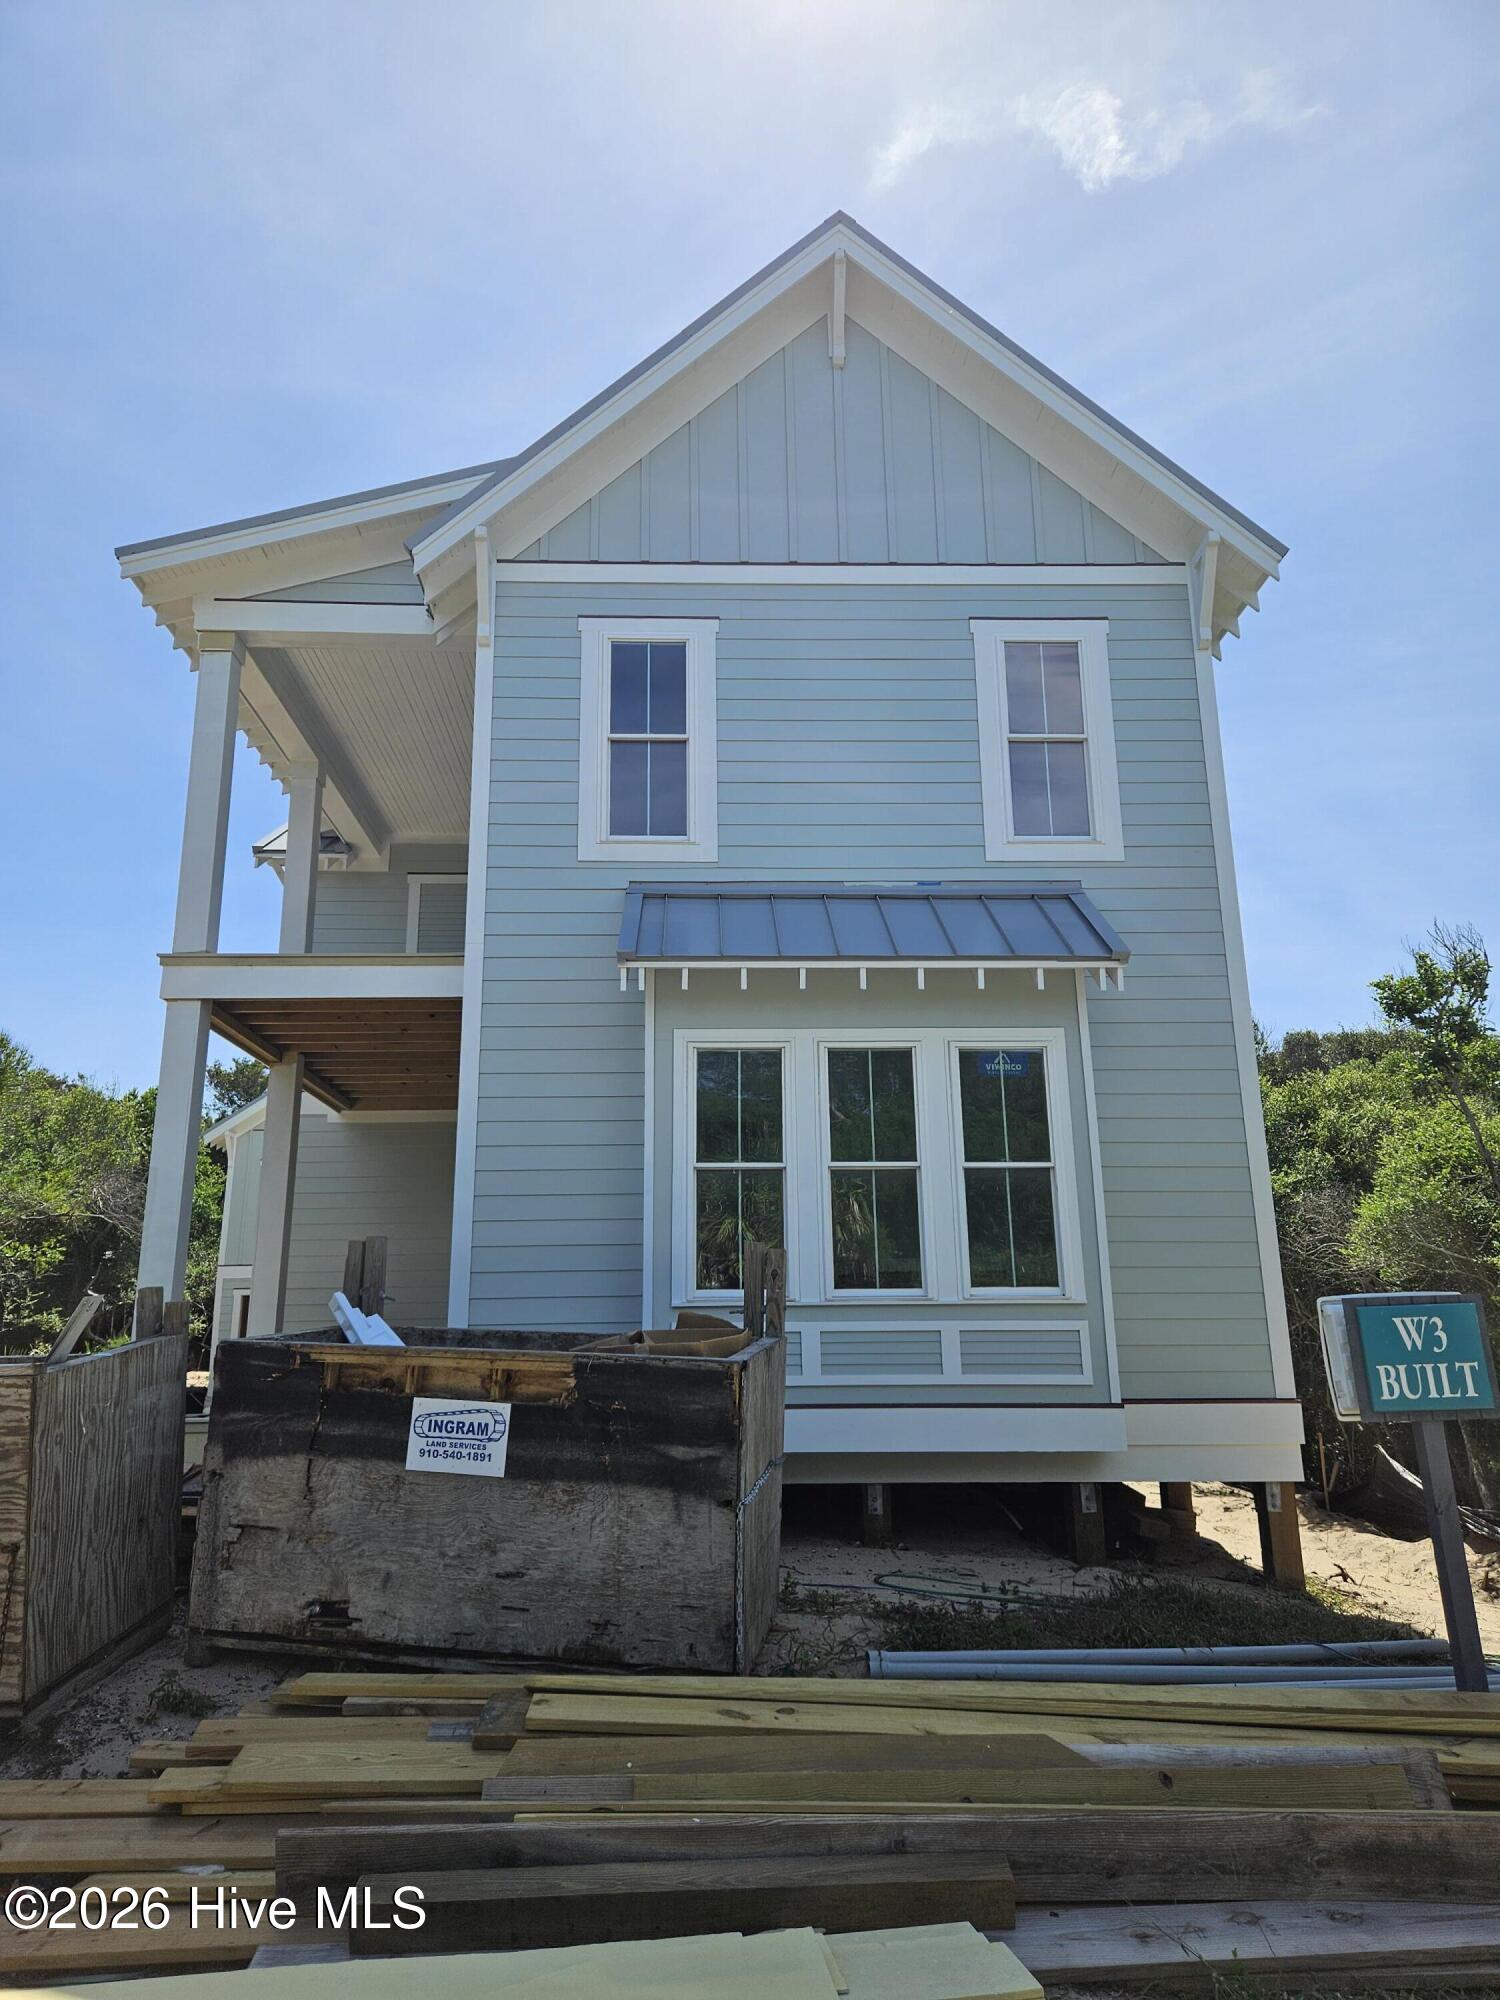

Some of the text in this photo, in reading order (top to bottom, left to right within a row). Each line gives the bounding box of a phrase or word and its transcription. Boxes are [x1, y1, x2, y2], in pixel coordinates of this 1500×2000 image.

[1392, 1316, 1448, 1353] W3
[1375, 1361, 1480, 1400] BUILT
[427, 1419, 490, 1437] INGRAM
[426, 1440, 487, 1451] LAND SERVICES
[419, 1448, 493, 1463] 910-540-1891
